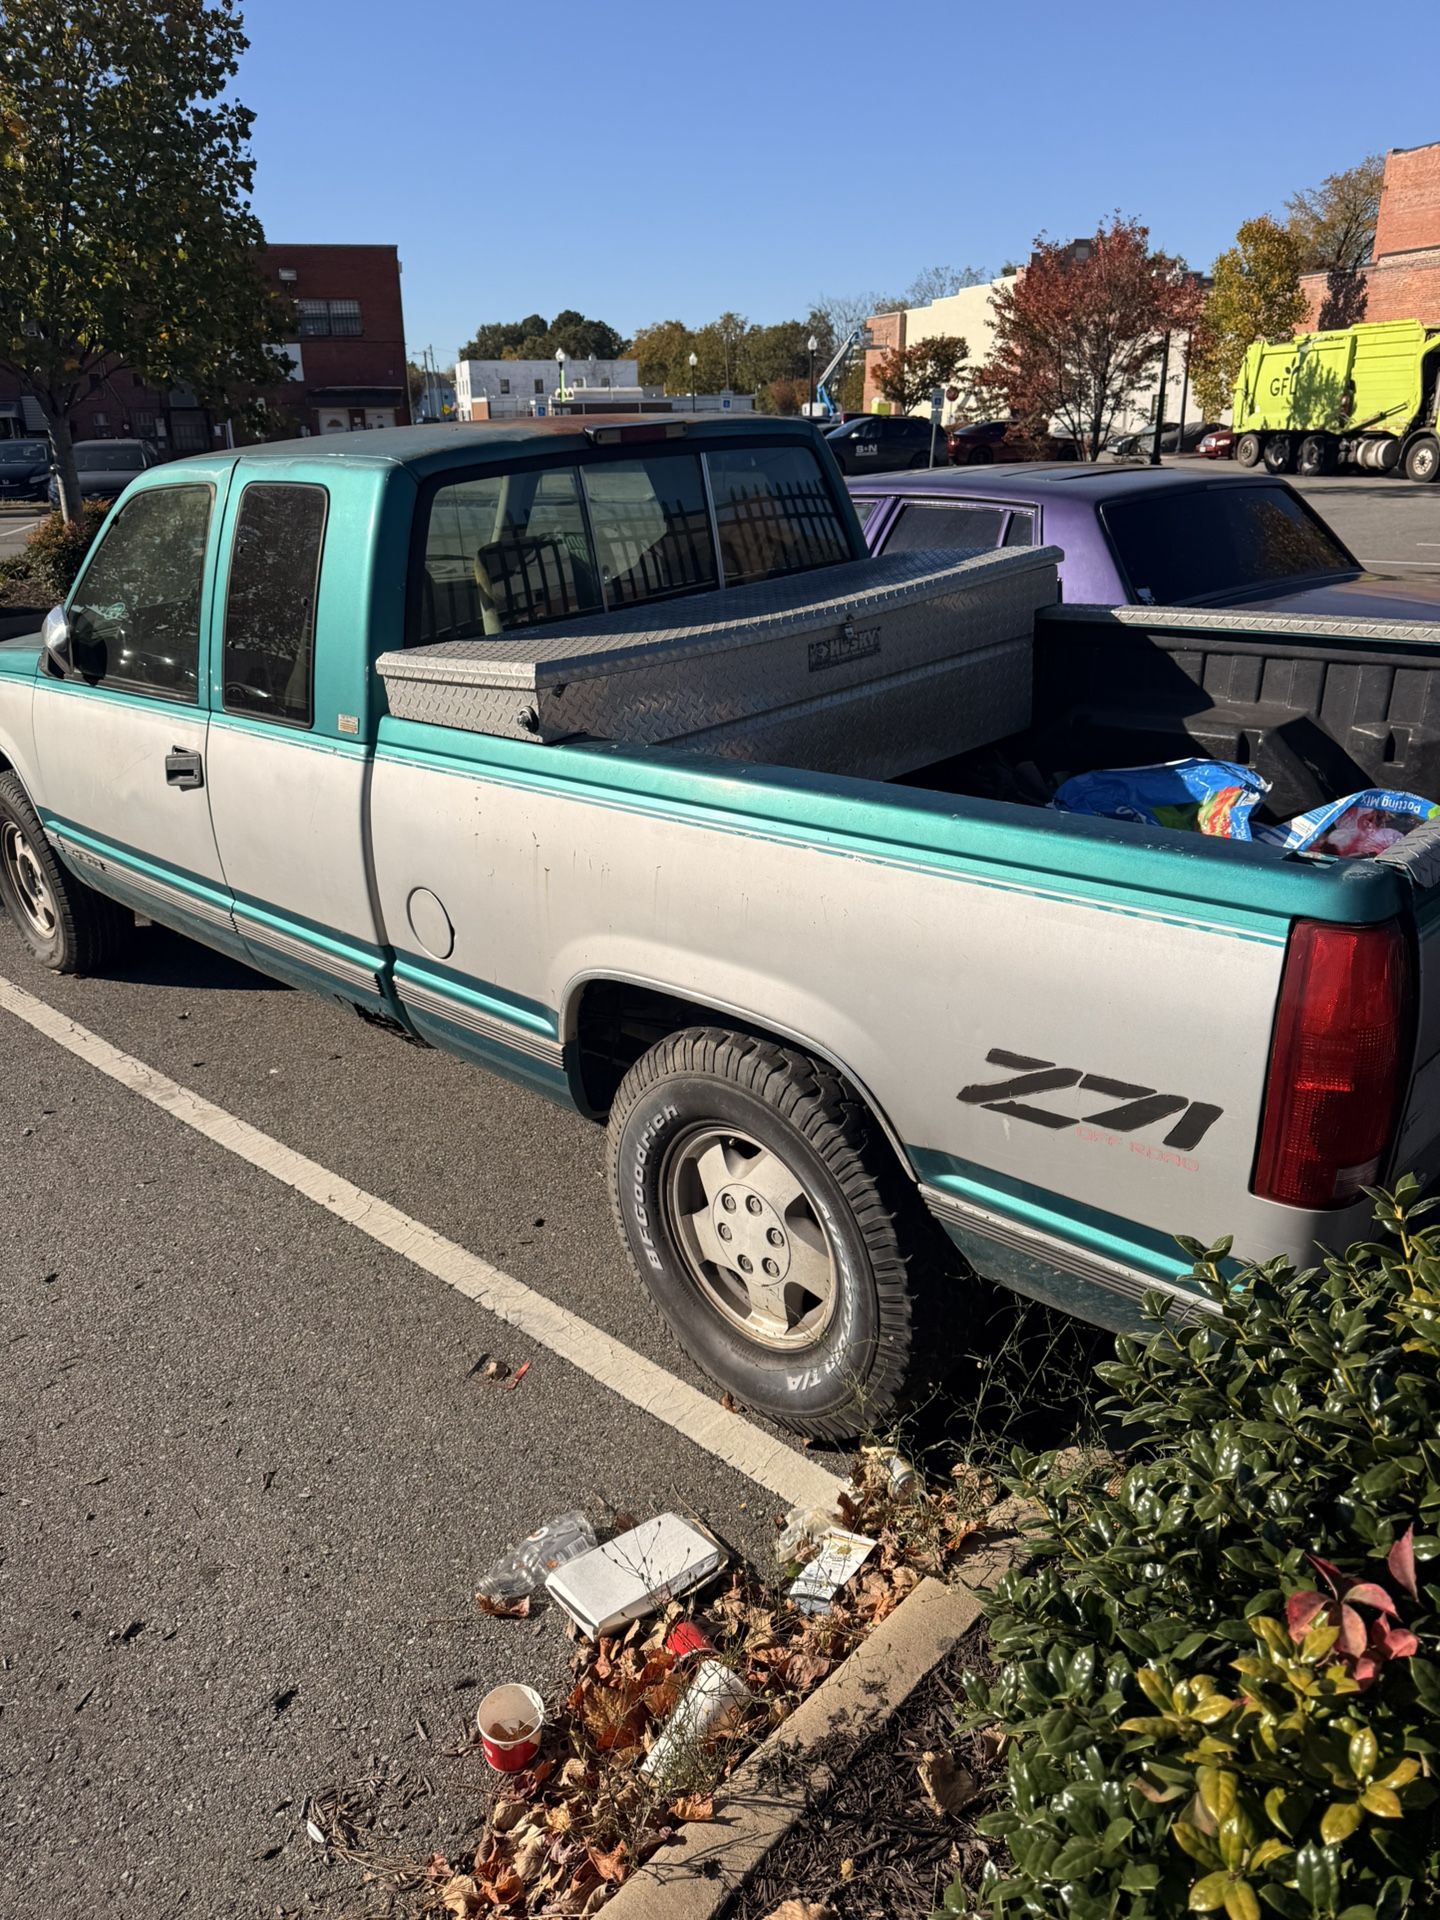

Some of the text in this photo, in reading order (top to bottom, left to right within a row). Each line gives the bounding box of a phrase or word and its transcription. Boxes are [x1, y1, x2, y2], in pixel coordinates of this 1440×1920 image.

[1270, 371, 1297, 397] GFL
[1360, 795, 1380, 807] Mix
[1381, 796, 1421, 814] Potting
[956, 1048, 1225, 1151] Z71
[1075, 1126, 1199, 1172] OFF ROAD
[634, 1104, 679, 1270] BFGoodrich
[786, 1369, 822, 1392] T/A
